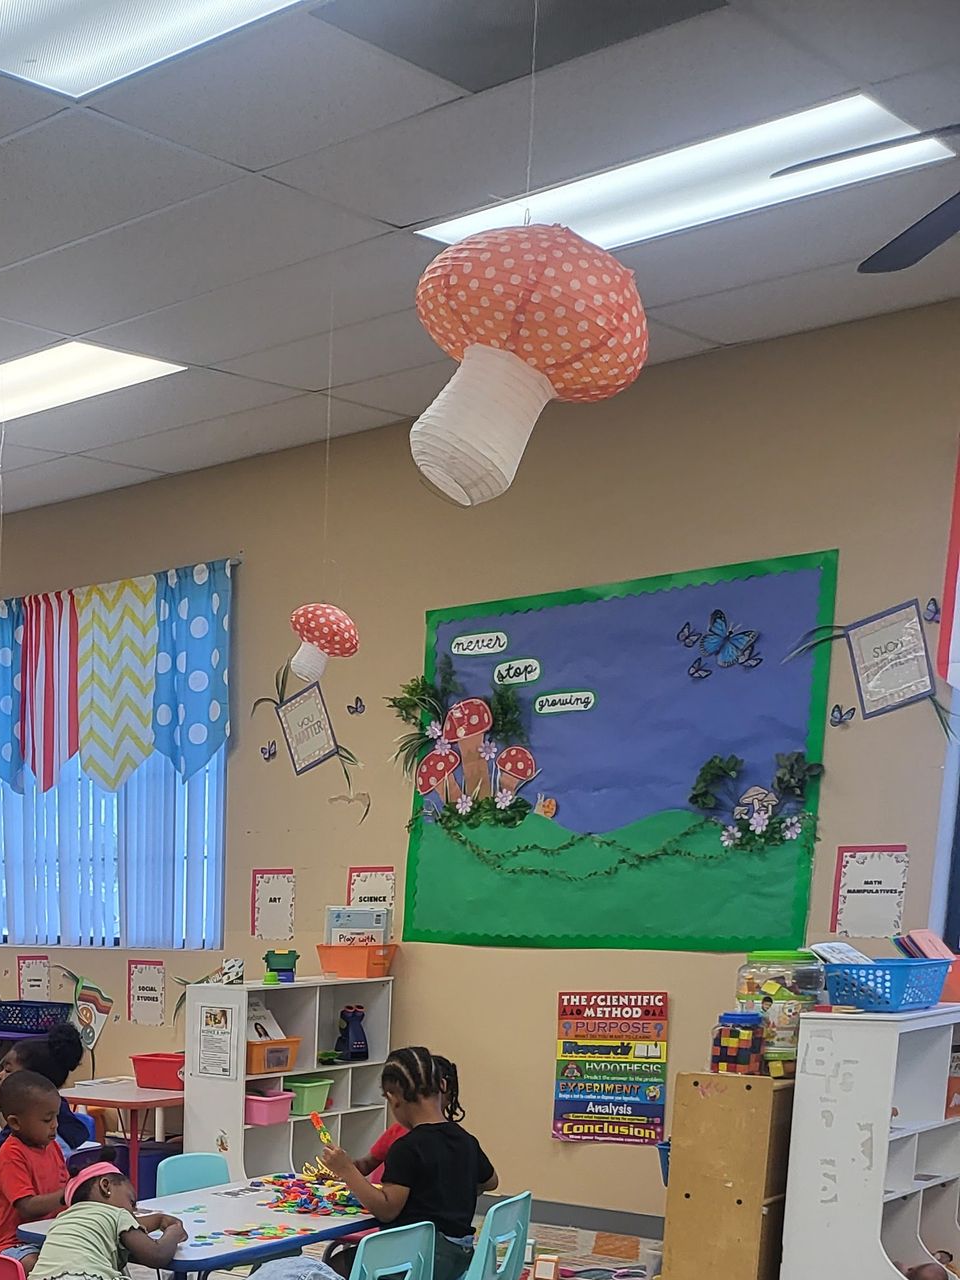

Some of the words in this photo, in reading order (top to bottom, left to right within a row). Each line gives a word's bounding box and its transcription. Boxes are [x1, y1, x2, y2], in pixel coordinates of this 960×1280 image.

[453, 635, 506, 652] never
[496, 663, 538, 683] stop
[538, 694, 593, 712] growing
[297, 713, 315, 728] YOU
[338, 934, 356, 946] Play
[358, 934, 376, 943] with
[138, 985, 158, 993] SOCIAL
[136, 995, 159, 1003] STUDIES
[562, 995, 588, 1006] THE
[589, 995, 664, 1007] SCIENTIFIC
[583, 1007, 642, 1018] METHOD
[575, 1021, 652, 1034] PURPOSE
[585, 1062, 662, 1074] HYPOTHESIS
[559, 1082, 641, 1095] EXPERIMENT
[586, 1101, 632, 1116] Analysis
[562, 1122, 656, 1139] Conclusion
